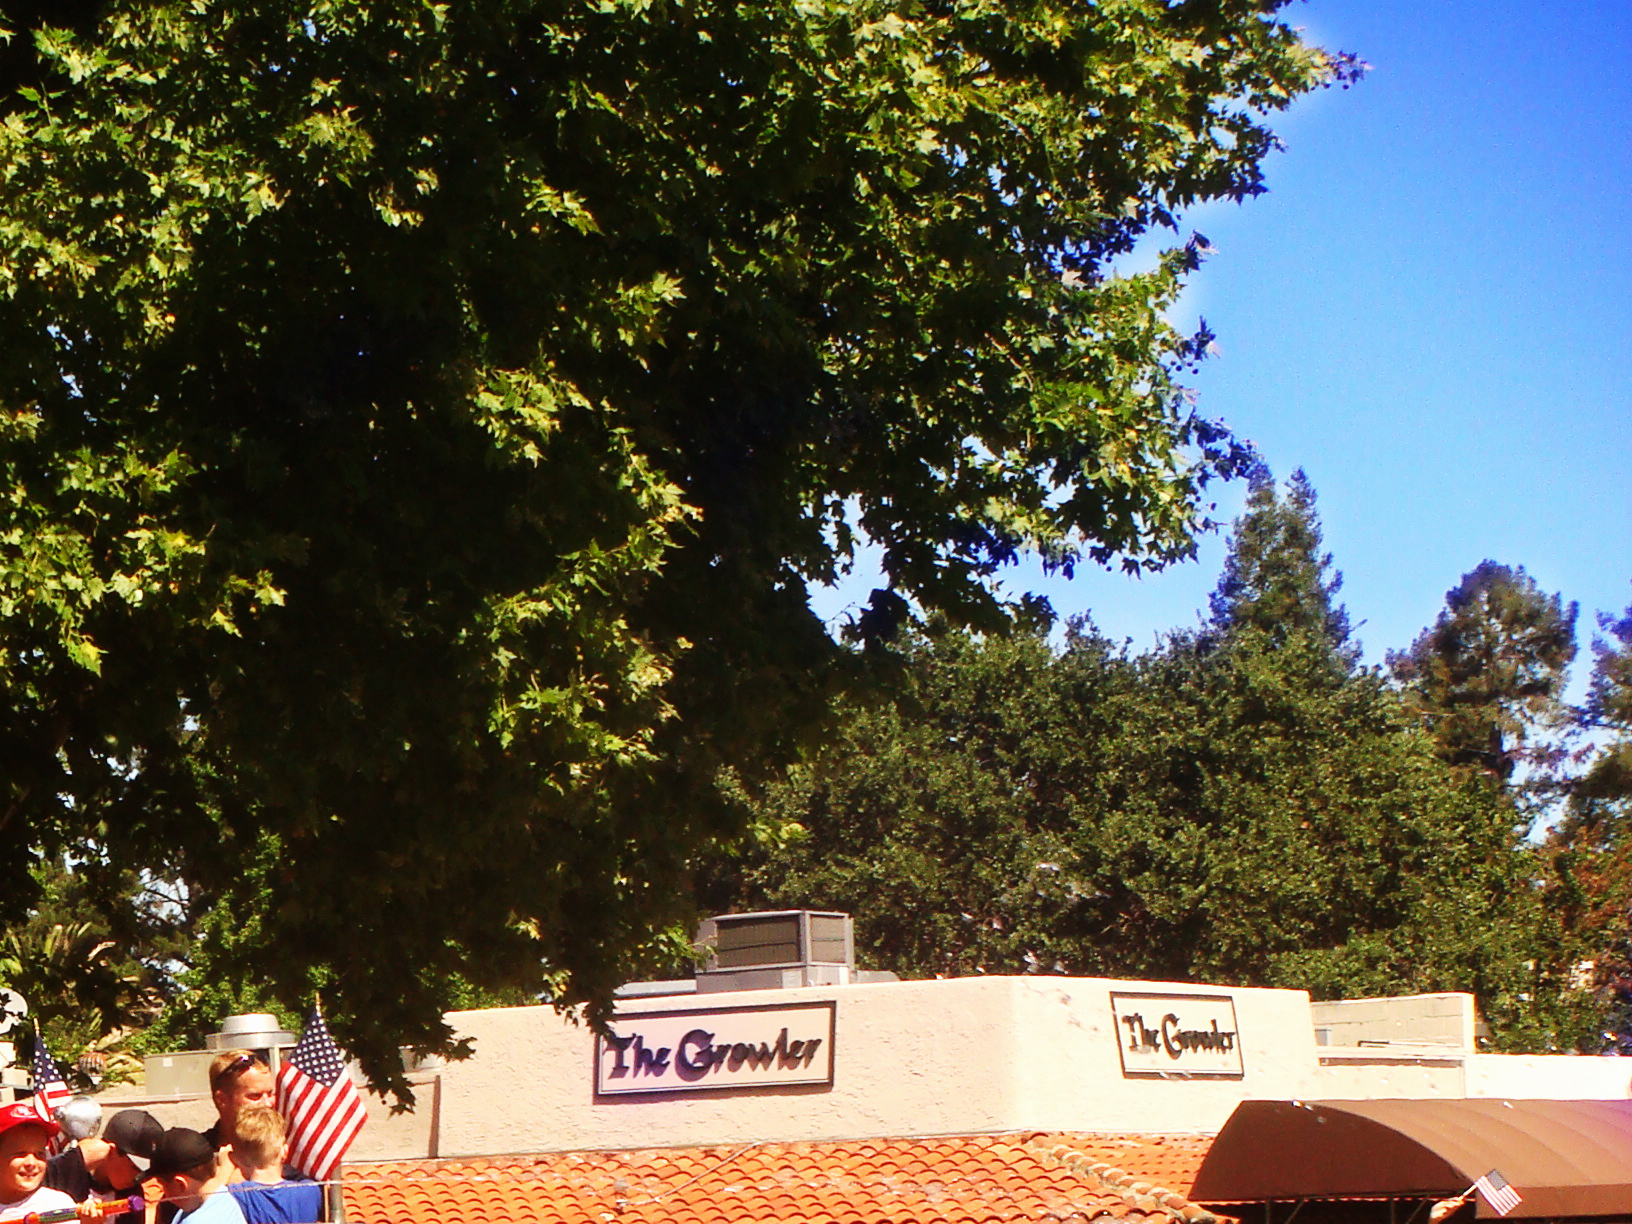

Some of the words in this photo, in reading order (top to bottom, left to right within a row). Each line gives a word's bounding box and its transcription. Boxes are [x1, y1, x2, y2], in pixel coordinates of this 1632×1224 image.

[604, 1033, 671, 1074] The
[676, 1028, 823, 1077] Growler
[1122, 1012, 1161, 1053] The
[1162, 1013, 1235, 1060] Growler
